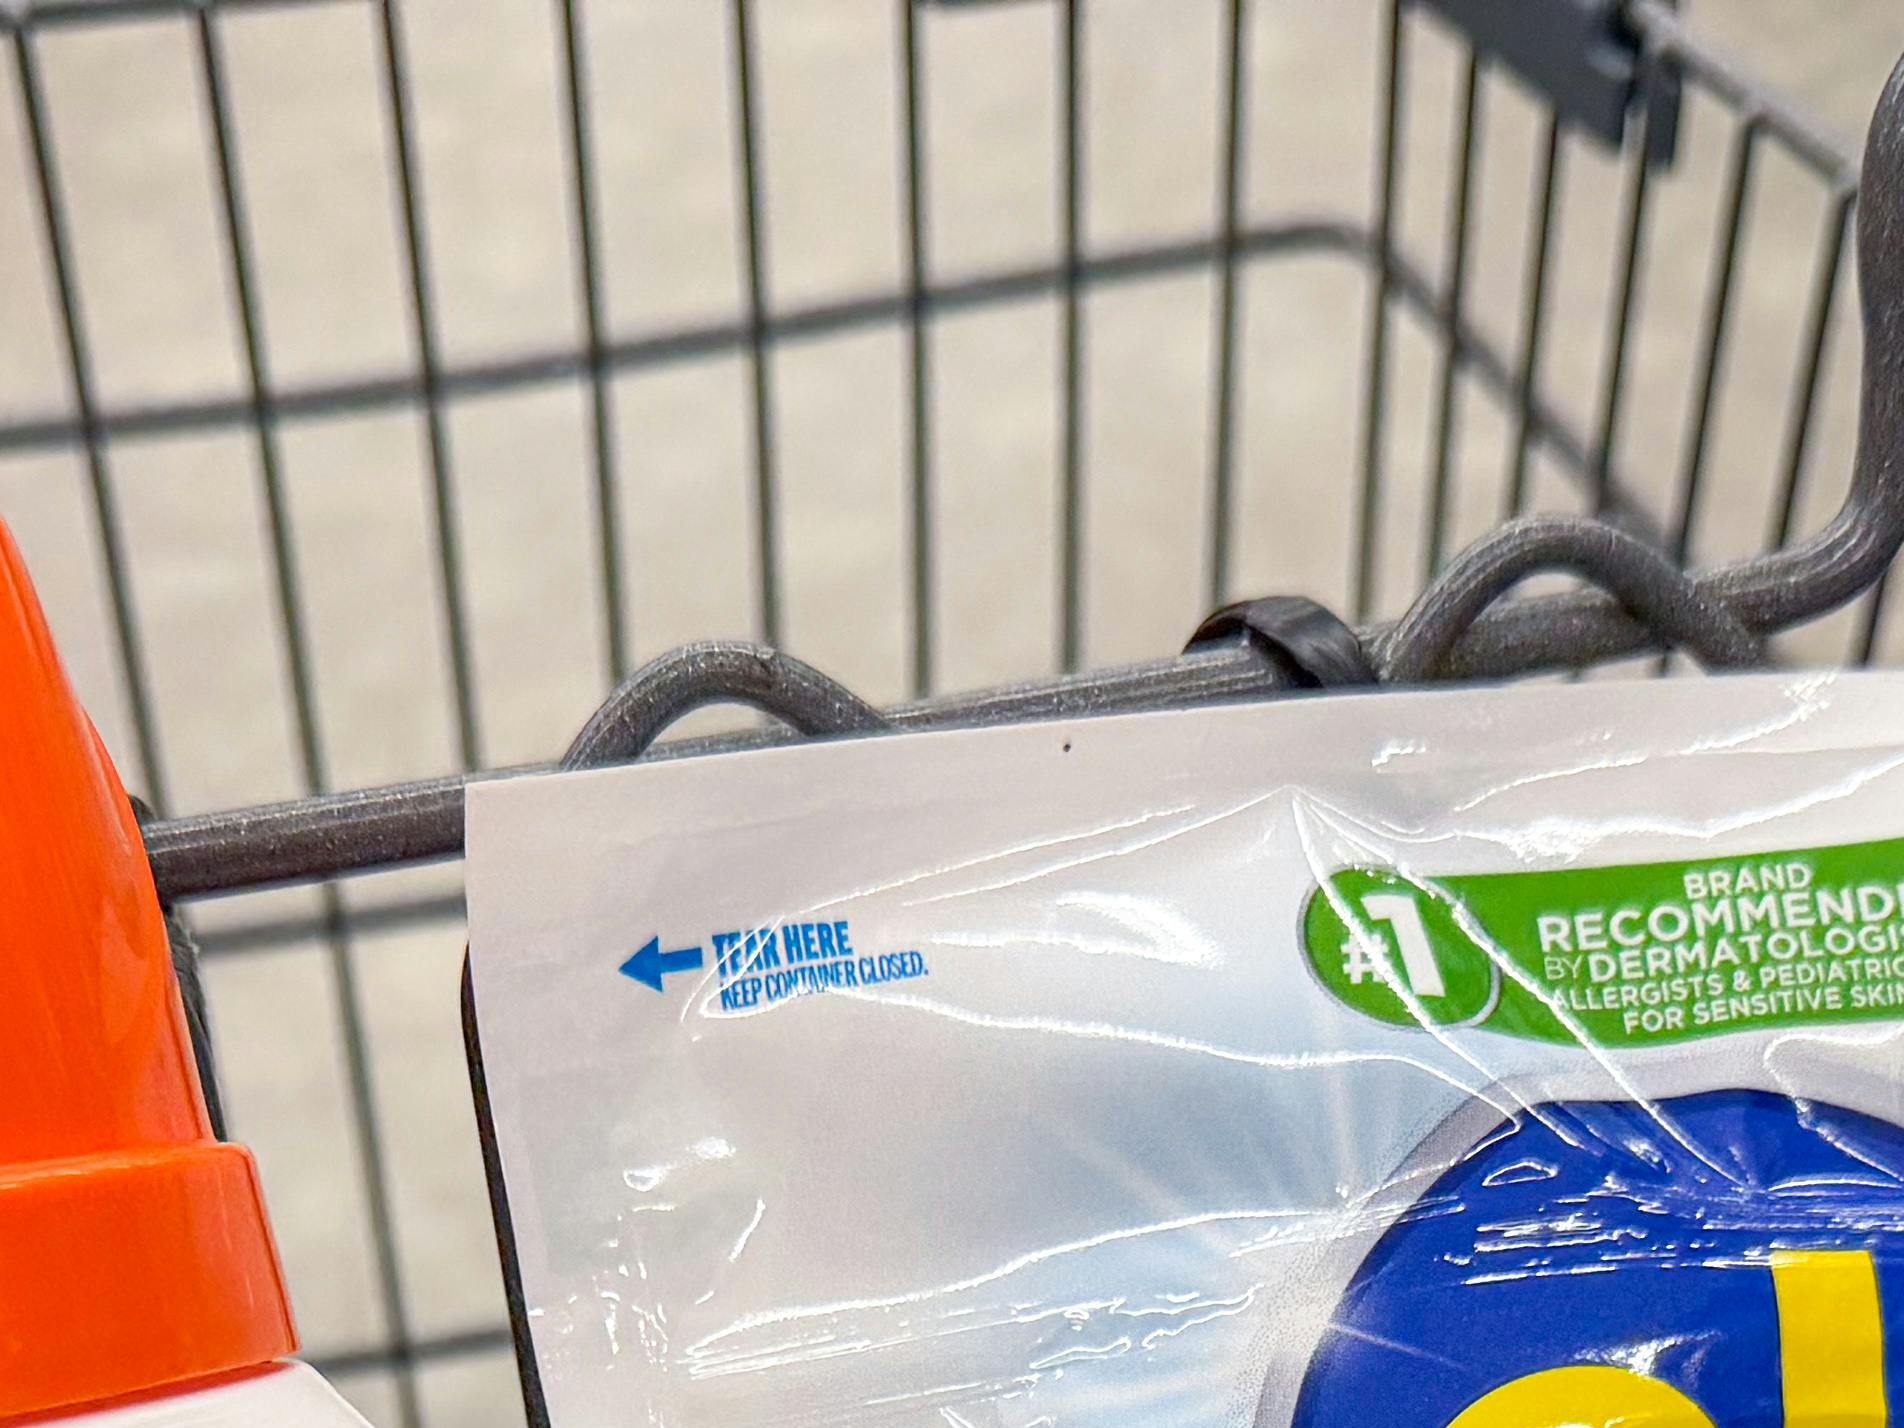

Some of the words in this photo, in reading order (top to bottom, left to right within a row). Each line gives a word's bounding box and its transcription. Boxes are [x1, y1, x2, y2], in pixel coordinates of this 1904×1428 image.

[1683, 862, 1812, 899] BRAND
[712, 926, 782, 978] TEAR
[783, 920, 854, 964] HERE
[1341, 892, 1446, 998] #1
[1543, 954, 1582, 981] BY
[720, 975, 762, 1012] KEEP
[765, 958, 860, 1004] CONTAINER
[859, 950, 929, 986] CLOSED.
[1552, 972, 1724, 1012] ALLERGISTS
[1732, 970, 1751, 993] &
[1623, 1006, 1684, 1035] FOR
[1693, 983, 1843, 1026] SENSITIVE
